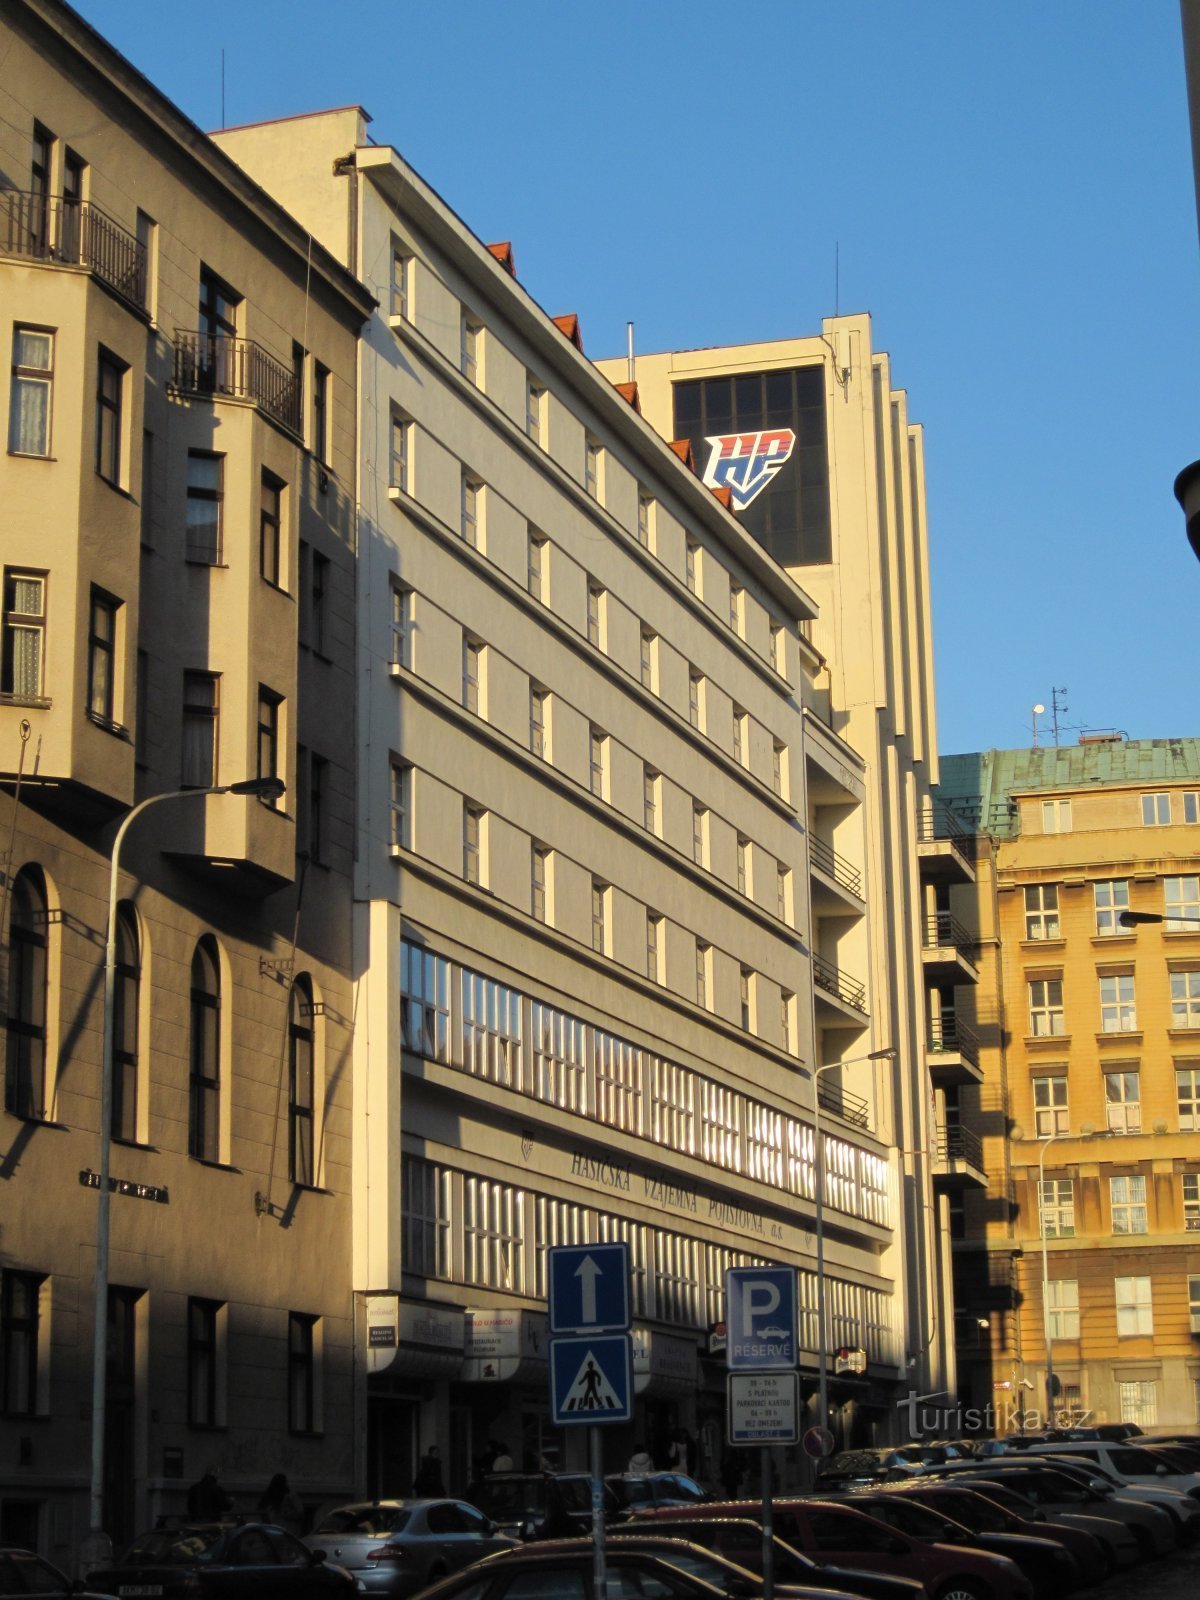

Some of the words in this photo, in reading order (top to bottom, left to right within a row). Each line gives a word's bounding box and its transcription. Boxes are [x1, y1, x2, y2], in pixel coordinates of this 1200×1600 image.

[571, 1150, 630, 1192] HASIČSKÁ
[644, 1172, 697, 1213] VZÁJEMNÁ
[742, 1281, 781, 1337] P
[734, 1341, 792, 1358] RÉSERVÉ
[768, 1399, 791, 1407] KARTOU
